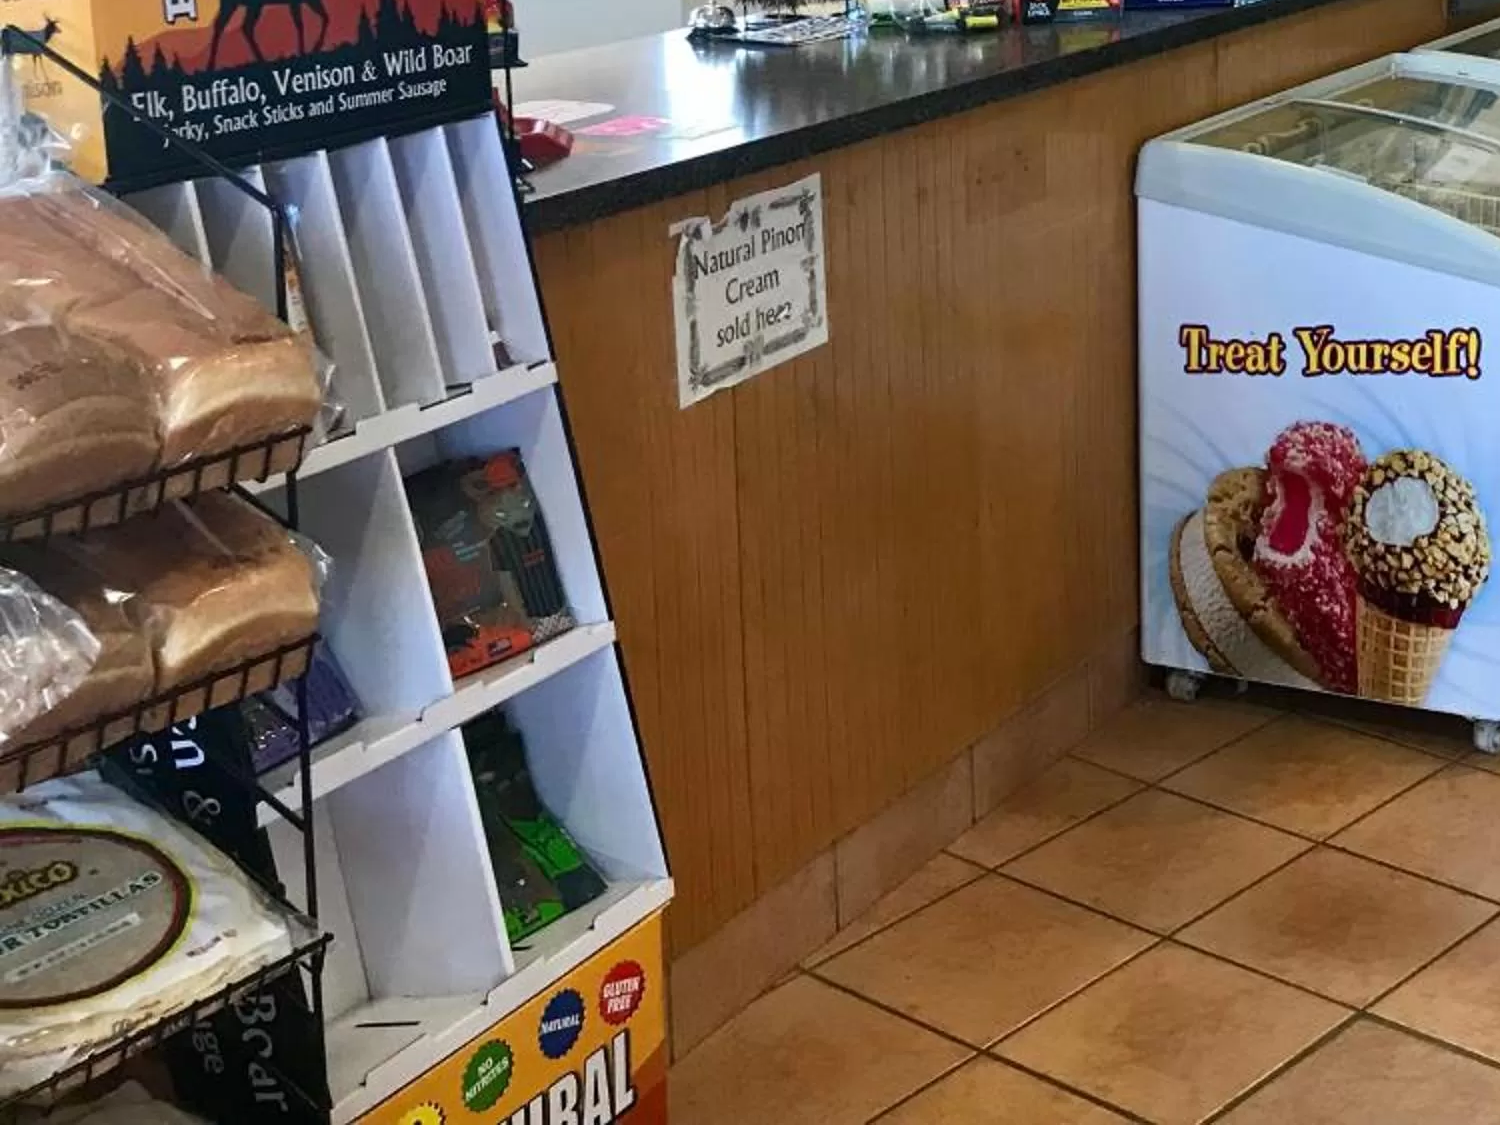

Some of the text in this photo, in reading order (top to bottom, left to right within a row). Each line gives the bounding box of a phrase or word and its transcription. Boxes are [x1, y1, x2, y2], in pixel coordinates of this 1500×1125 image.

[182, 77, 267, 113] Buffalo,
[273, 63, 355, 96] Venison
[360, 59, 377, 82] &
[383, 48, 427, 78] Wild
[433, 42, 473, 68] Boar
[213, 112, 259, 136] Snack
[263, 102, 305, 128] Sticks
[308, 95, 334, 117] and
[338, 87, 394, 111] Summer
[398, 77, 448, 104] Sausage
[692, 222, 806, 279] Natural Pinon
[724, 268, 780, 305] Cream
[715, 315, 750, 348] sold
[1180, 324, 1482, 380] Treat Yourself!
[25, 869, 163, 942] TORTILLAS
[603, 976, 640, 1000] GLUTEN
[607, 994, 634, 1014] FREE
[541, 1013, 580, 1034] NATURAL
[464, 1056, 510, 1102] NITRITES
[477, 1056, 494, 1074] NO
